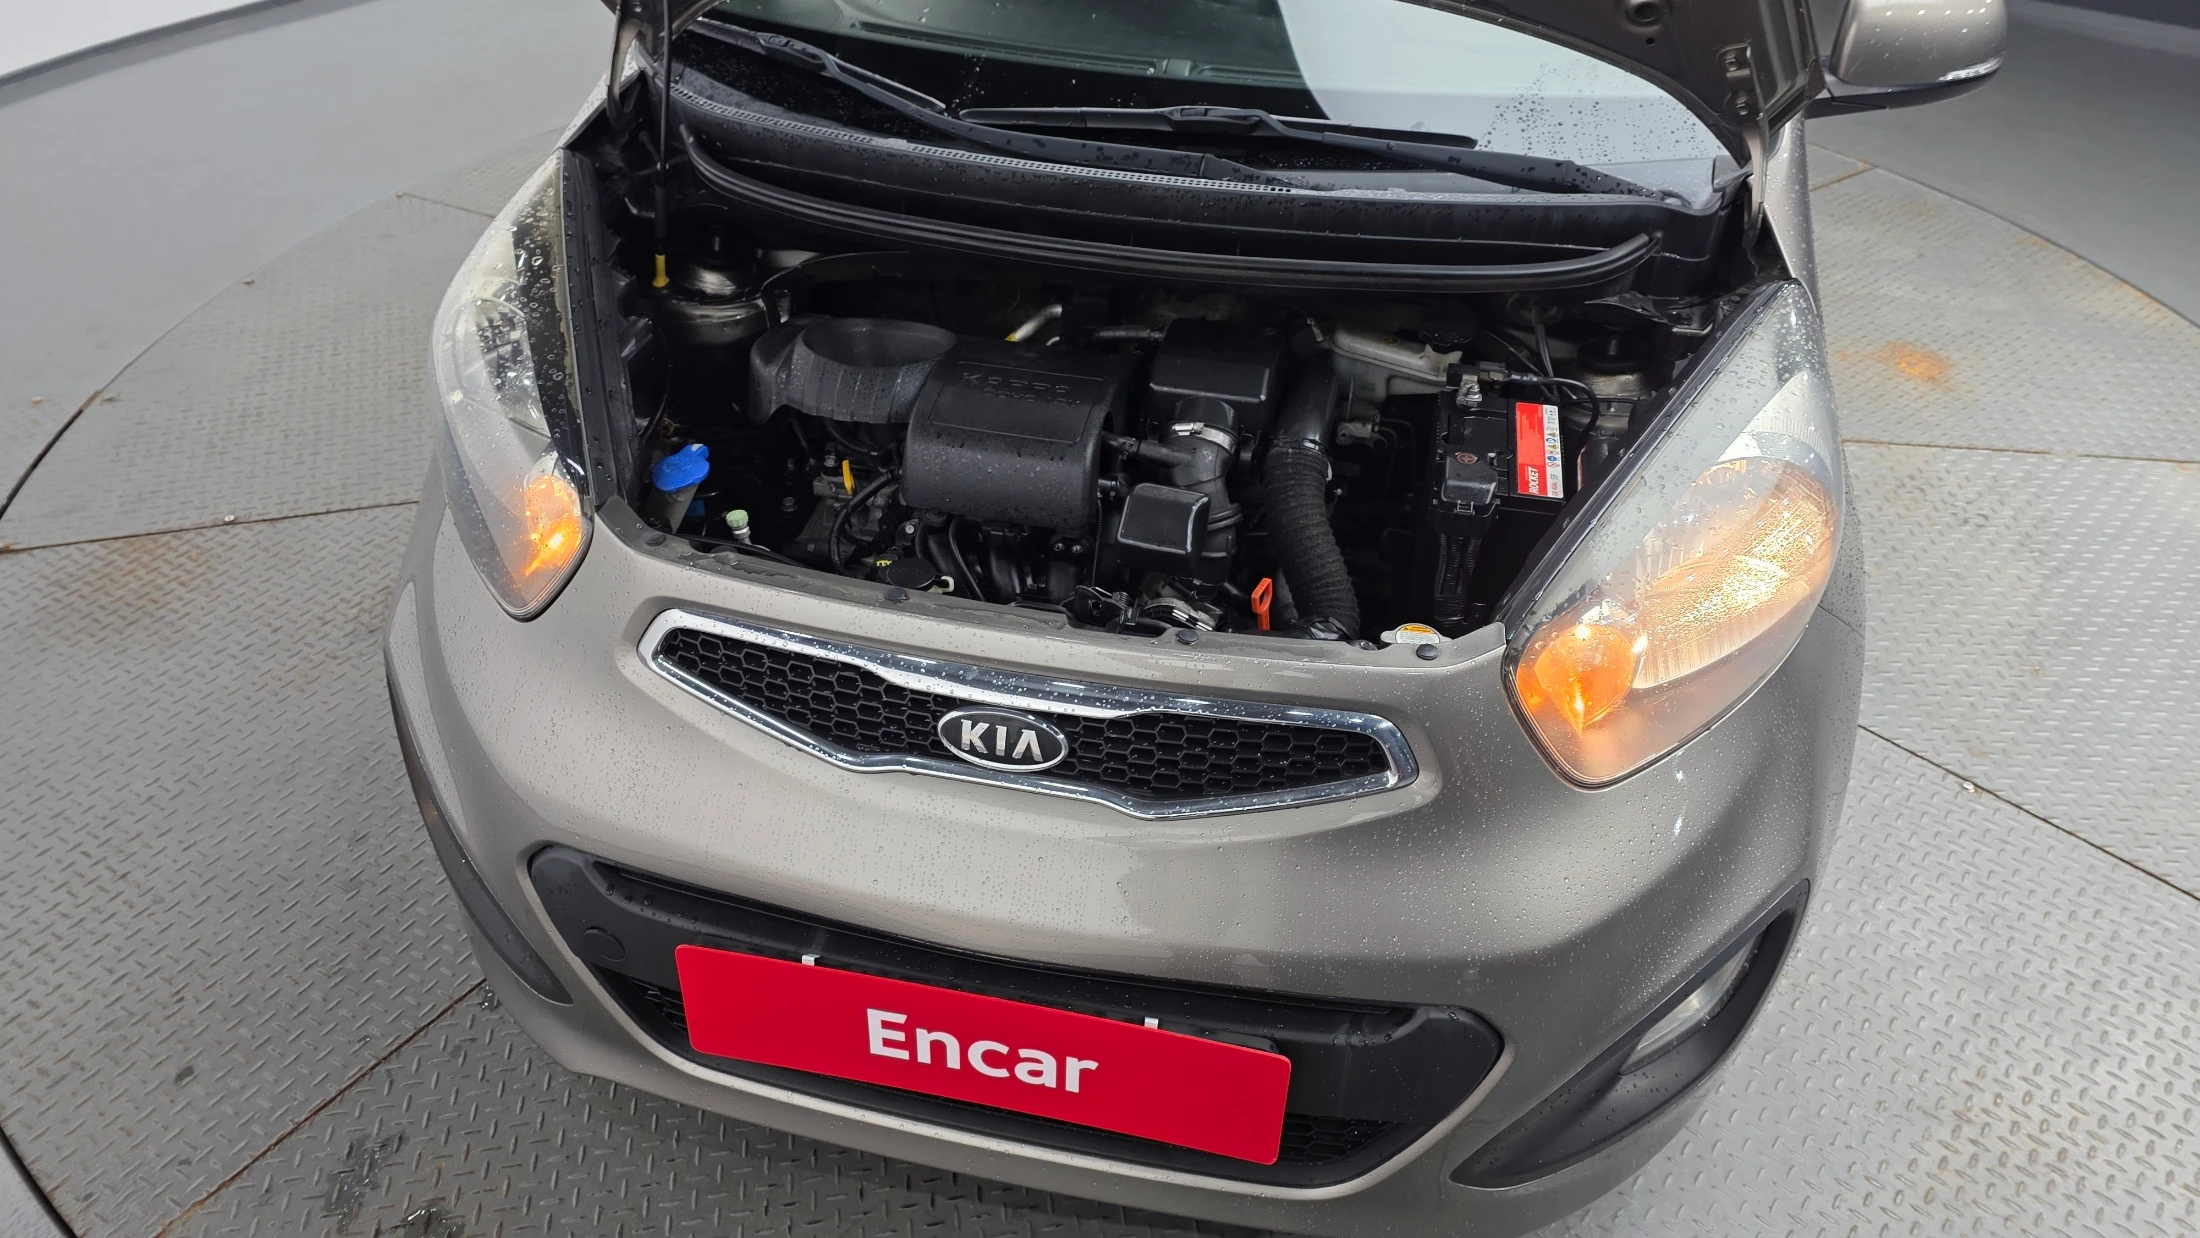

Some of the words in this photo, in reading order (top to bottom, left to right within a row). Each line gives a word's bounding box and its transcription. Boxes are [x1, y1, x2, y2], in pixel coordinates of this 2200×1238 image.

[1528, 466, 1539, 495] ROCKET
[960, 719, 1044, 762] KIA
[866, 1008, 1100, 1094] Encar
